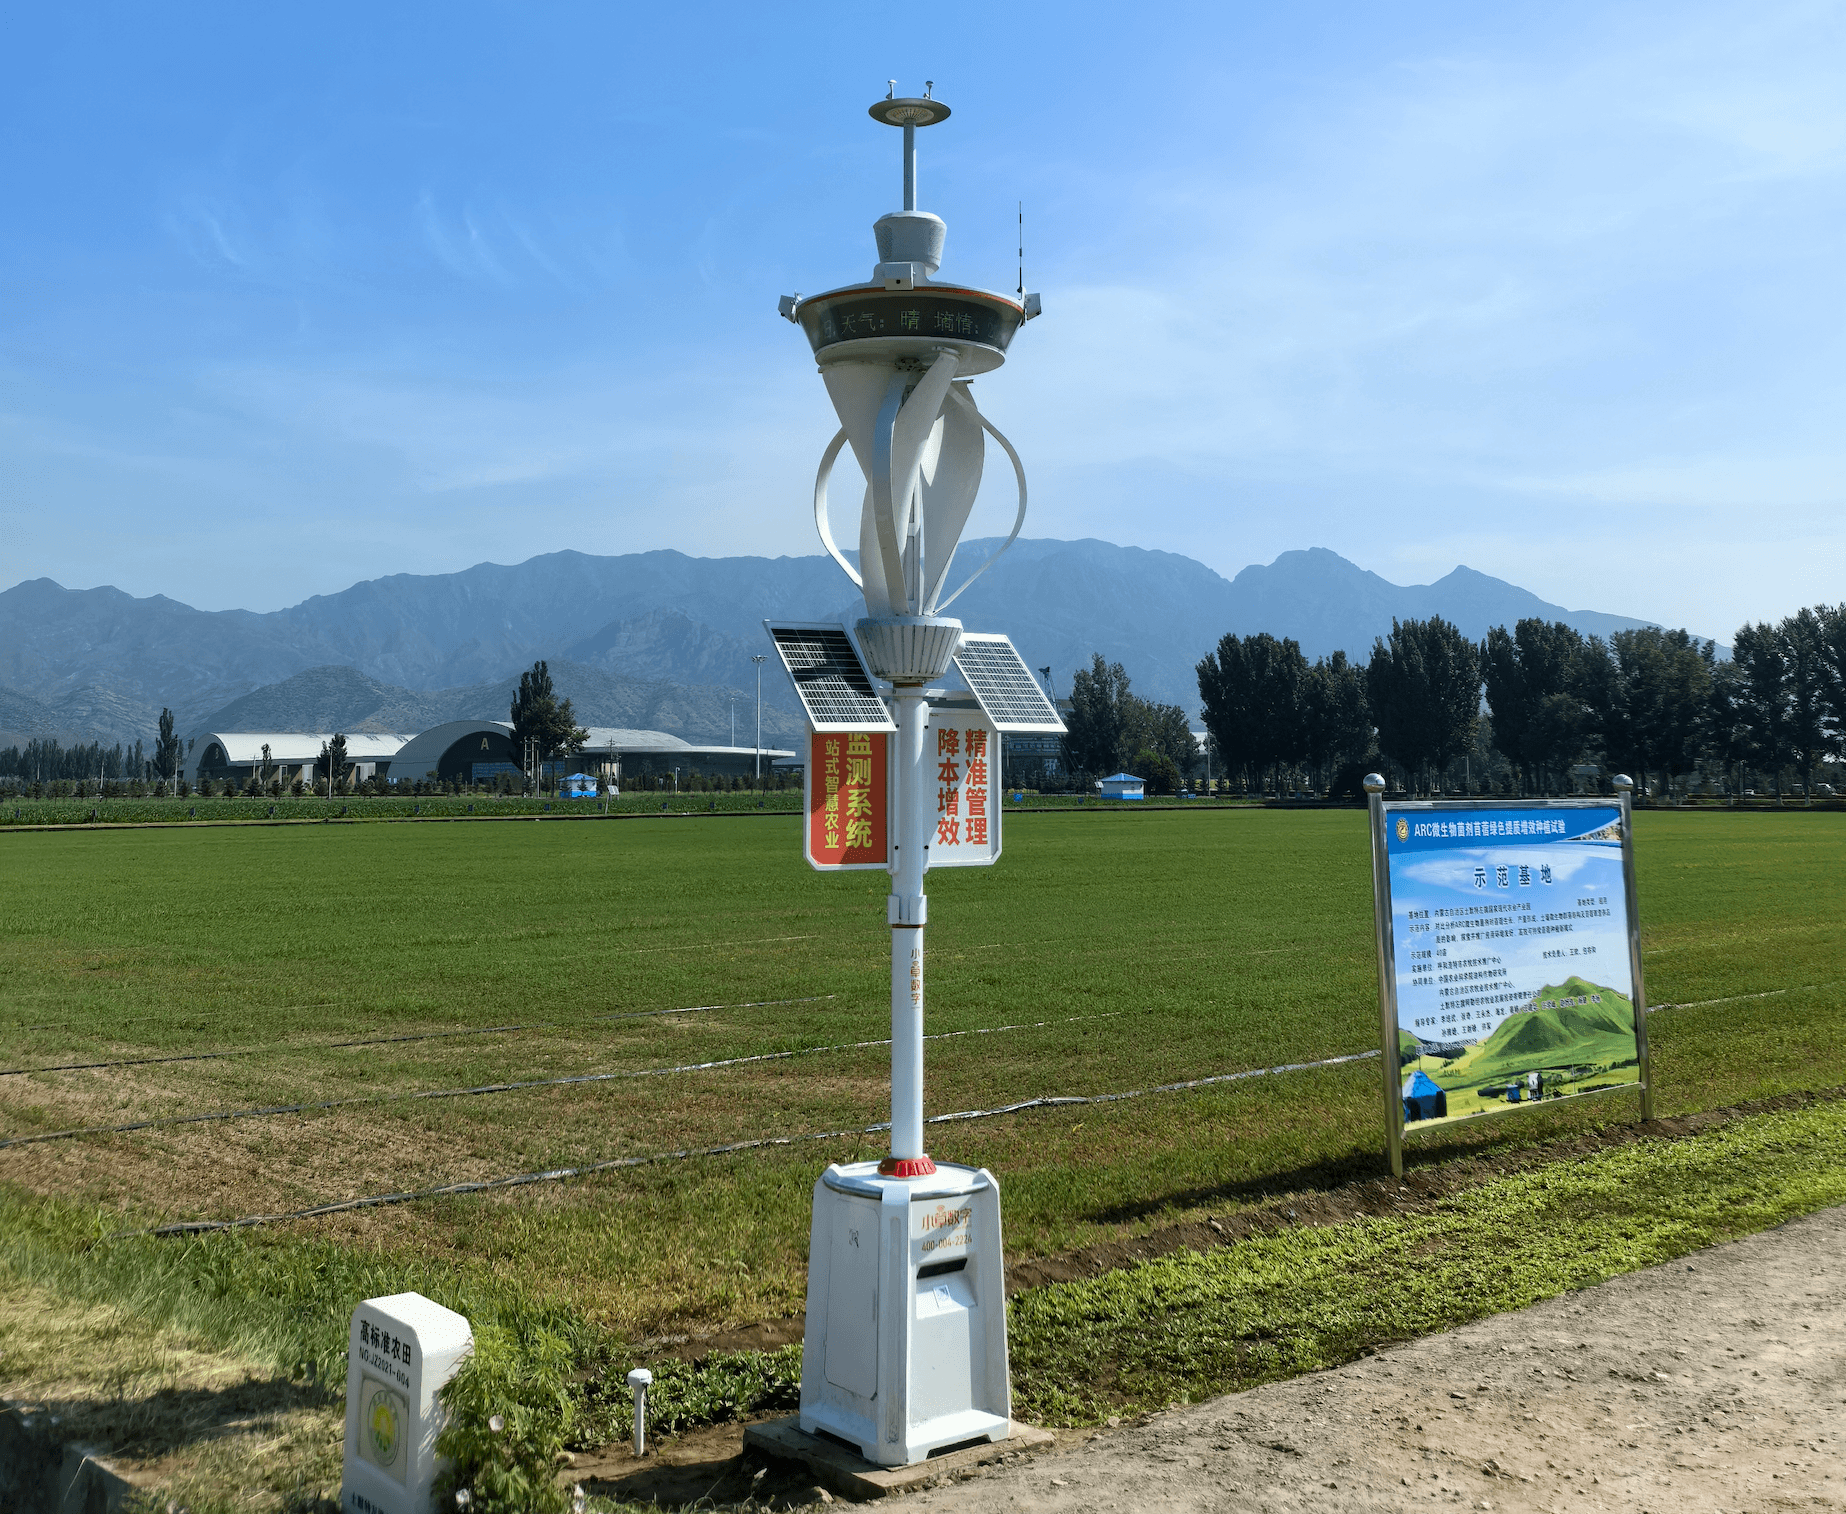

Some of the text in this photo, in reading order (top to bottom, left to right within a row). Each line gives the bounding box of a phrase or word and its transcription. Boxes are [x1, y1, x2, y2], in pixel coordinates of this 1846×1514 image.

[480, 737, 490, 750] A
[824, 738, 840, 849] 站式智慧农业
[846, 733, 873, 849] 监测系统
[937, 728, 960, 846] 降本增效
[965, 728, 988, 845] 精准管理
[1474, 863, 1553, 889] 示范基地
[360, 1319, 411, 1367] 高标准农田
